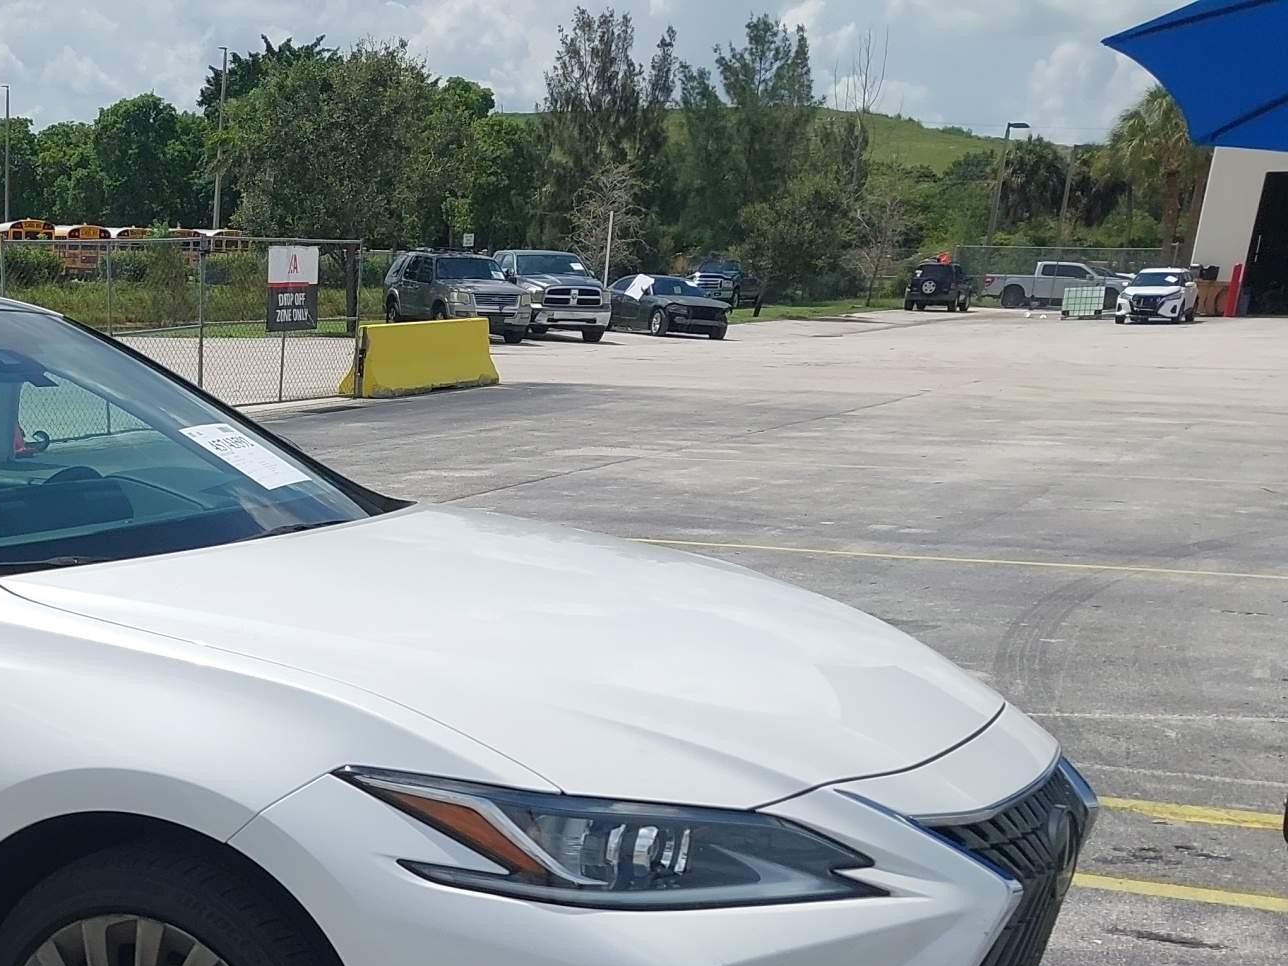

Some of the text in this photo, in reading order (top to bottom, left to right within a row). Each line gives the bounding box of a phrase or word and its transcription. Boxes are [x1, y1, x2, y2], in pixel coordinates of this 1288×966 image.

[278, 292, 306, 306] DROP OFF
[276, 308, 309, 322] ZONE ONLY
